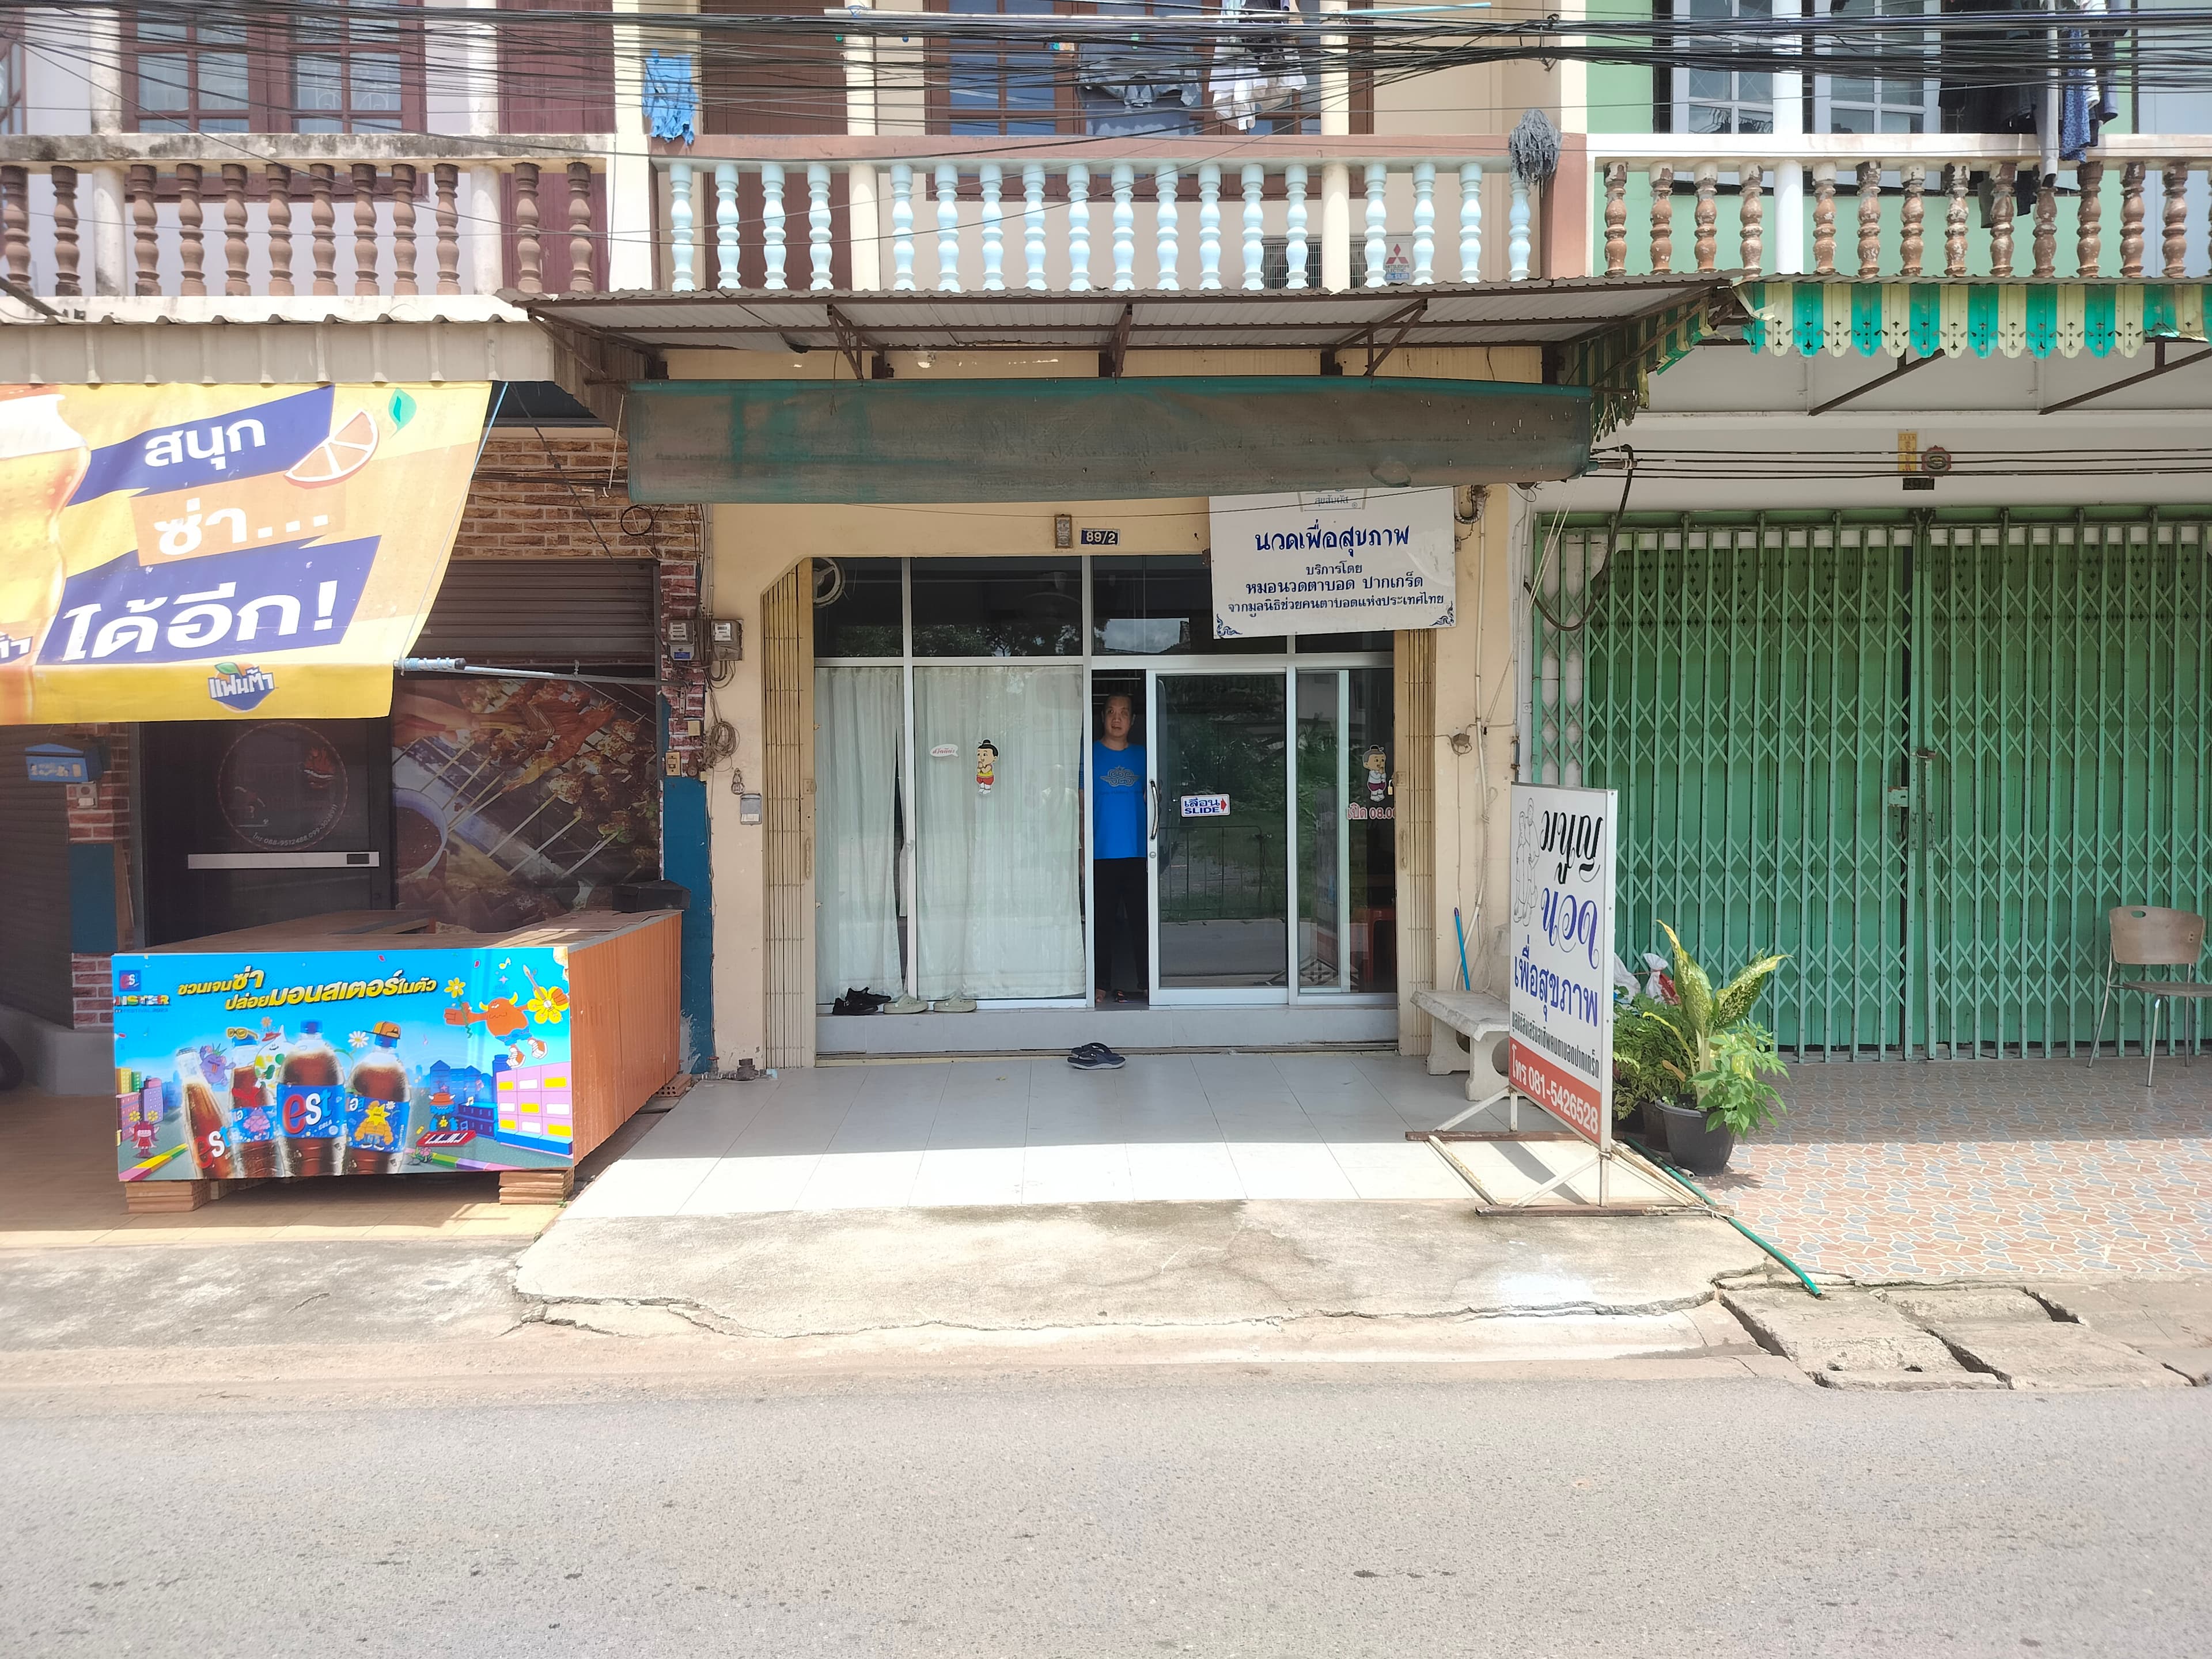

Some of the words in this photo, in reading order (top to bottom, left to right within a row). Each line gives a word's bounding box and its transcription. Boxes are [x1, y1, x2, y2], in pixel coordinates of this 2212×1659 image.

[144, 418, 267, 471] สนุก
[1086, 531, 1116, 544] 89/2
[1255, 519, 1410, 557] นวดเพื่อสุขภาพ
[1245, 578, 1355, 594] หมอนวดตาบอด
[1362, 571, 1423, 590] ปากเกร็ด
[1306, 560, 1362, 575] บริการโดย
[60, 580, 339, 662] ได้อีก!
[1228, 592, 1444, 618] จากมูลนิธิช่วยคนตาบอดแห่งประเทศไทย
[1540, 887, 1599, 970] นวด
[1514, 934, 1598, 1028] เพื่อสุขภาพ
[1512, 1043, 1527, 1086] โทร
[1528, 1066, 1599, 1135] 081-5426528
[282, 1088, 332, 1134] est
[319, 1119, 332, 1130] COLA
[194, 1126, 231, 1169] est
